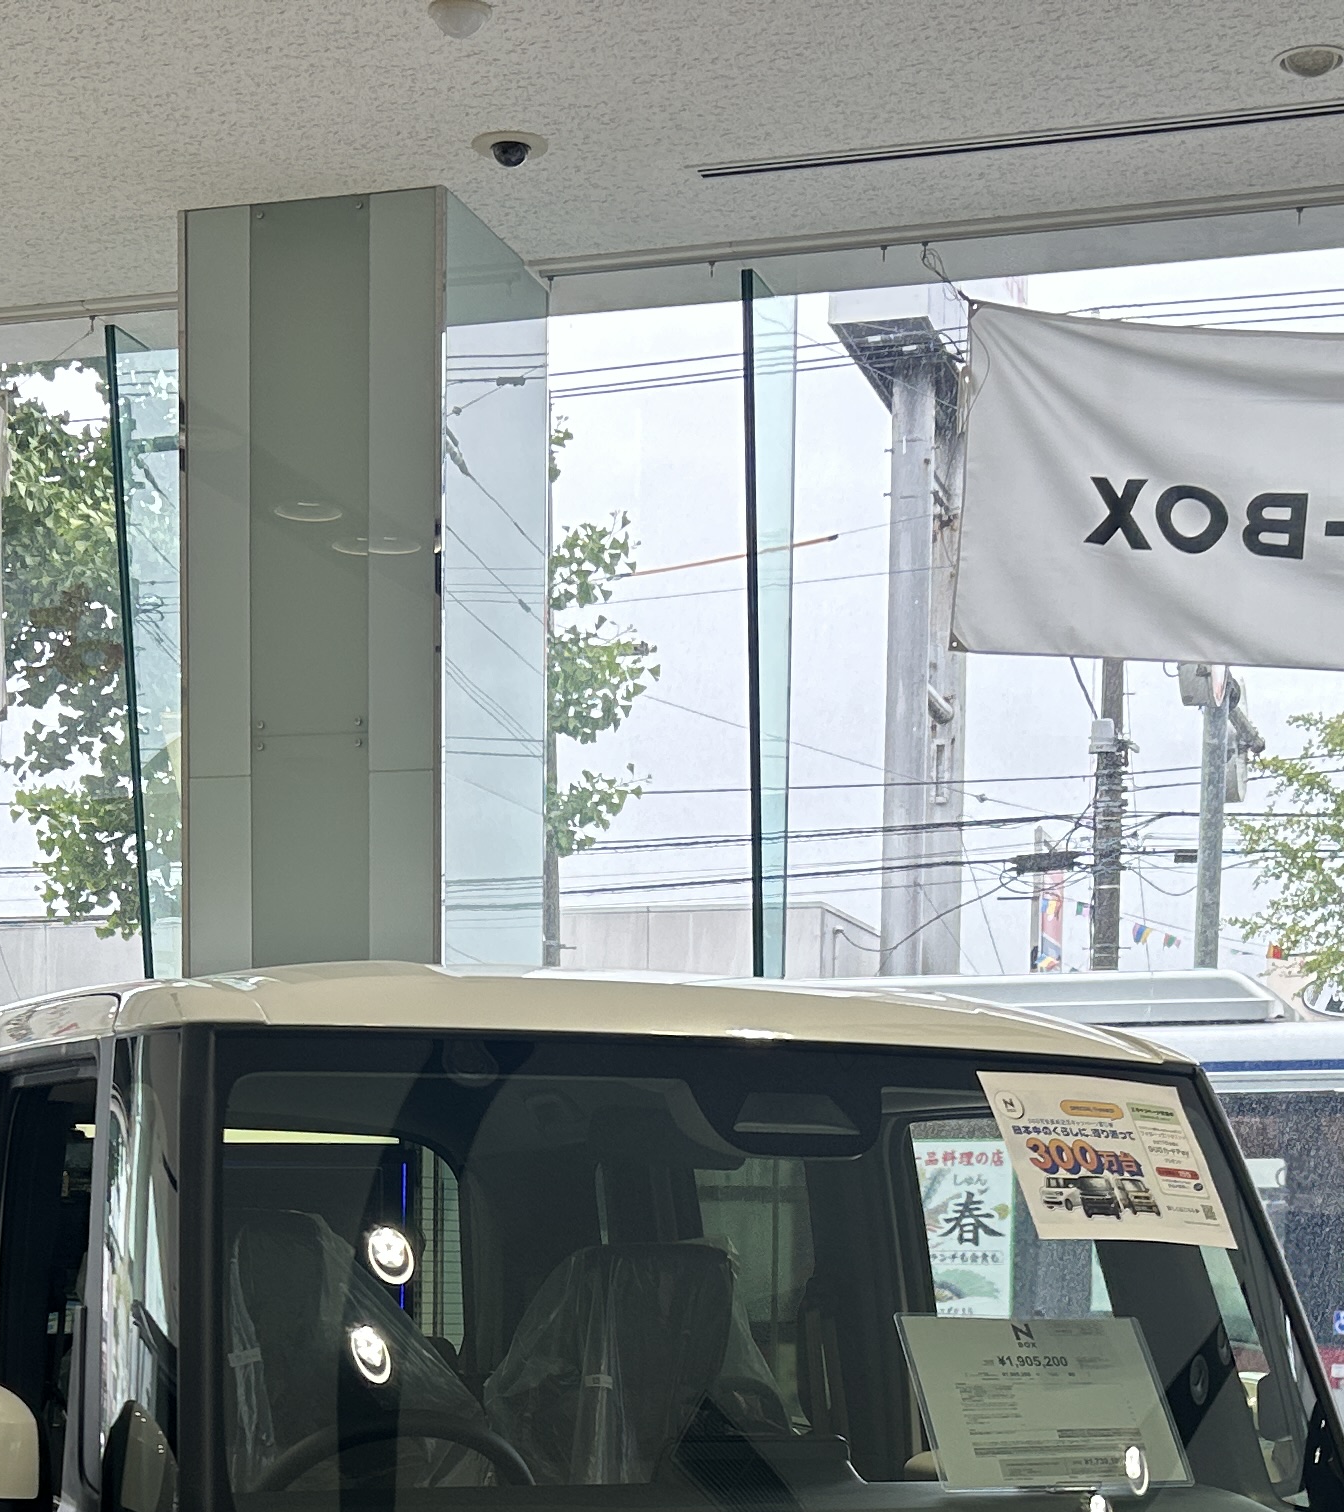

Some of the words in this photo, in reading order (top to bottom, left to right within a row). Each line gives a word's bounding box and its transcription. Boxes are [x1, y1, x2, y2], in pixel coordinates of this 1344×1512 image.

[1025, 1137, 1144, 1177] 300万台
[938, 1190, 1005, 1247] 春
[1010, 1323, 1034, 1341] N
[996, 1355, 1068, 1368] ¥1,905,200
